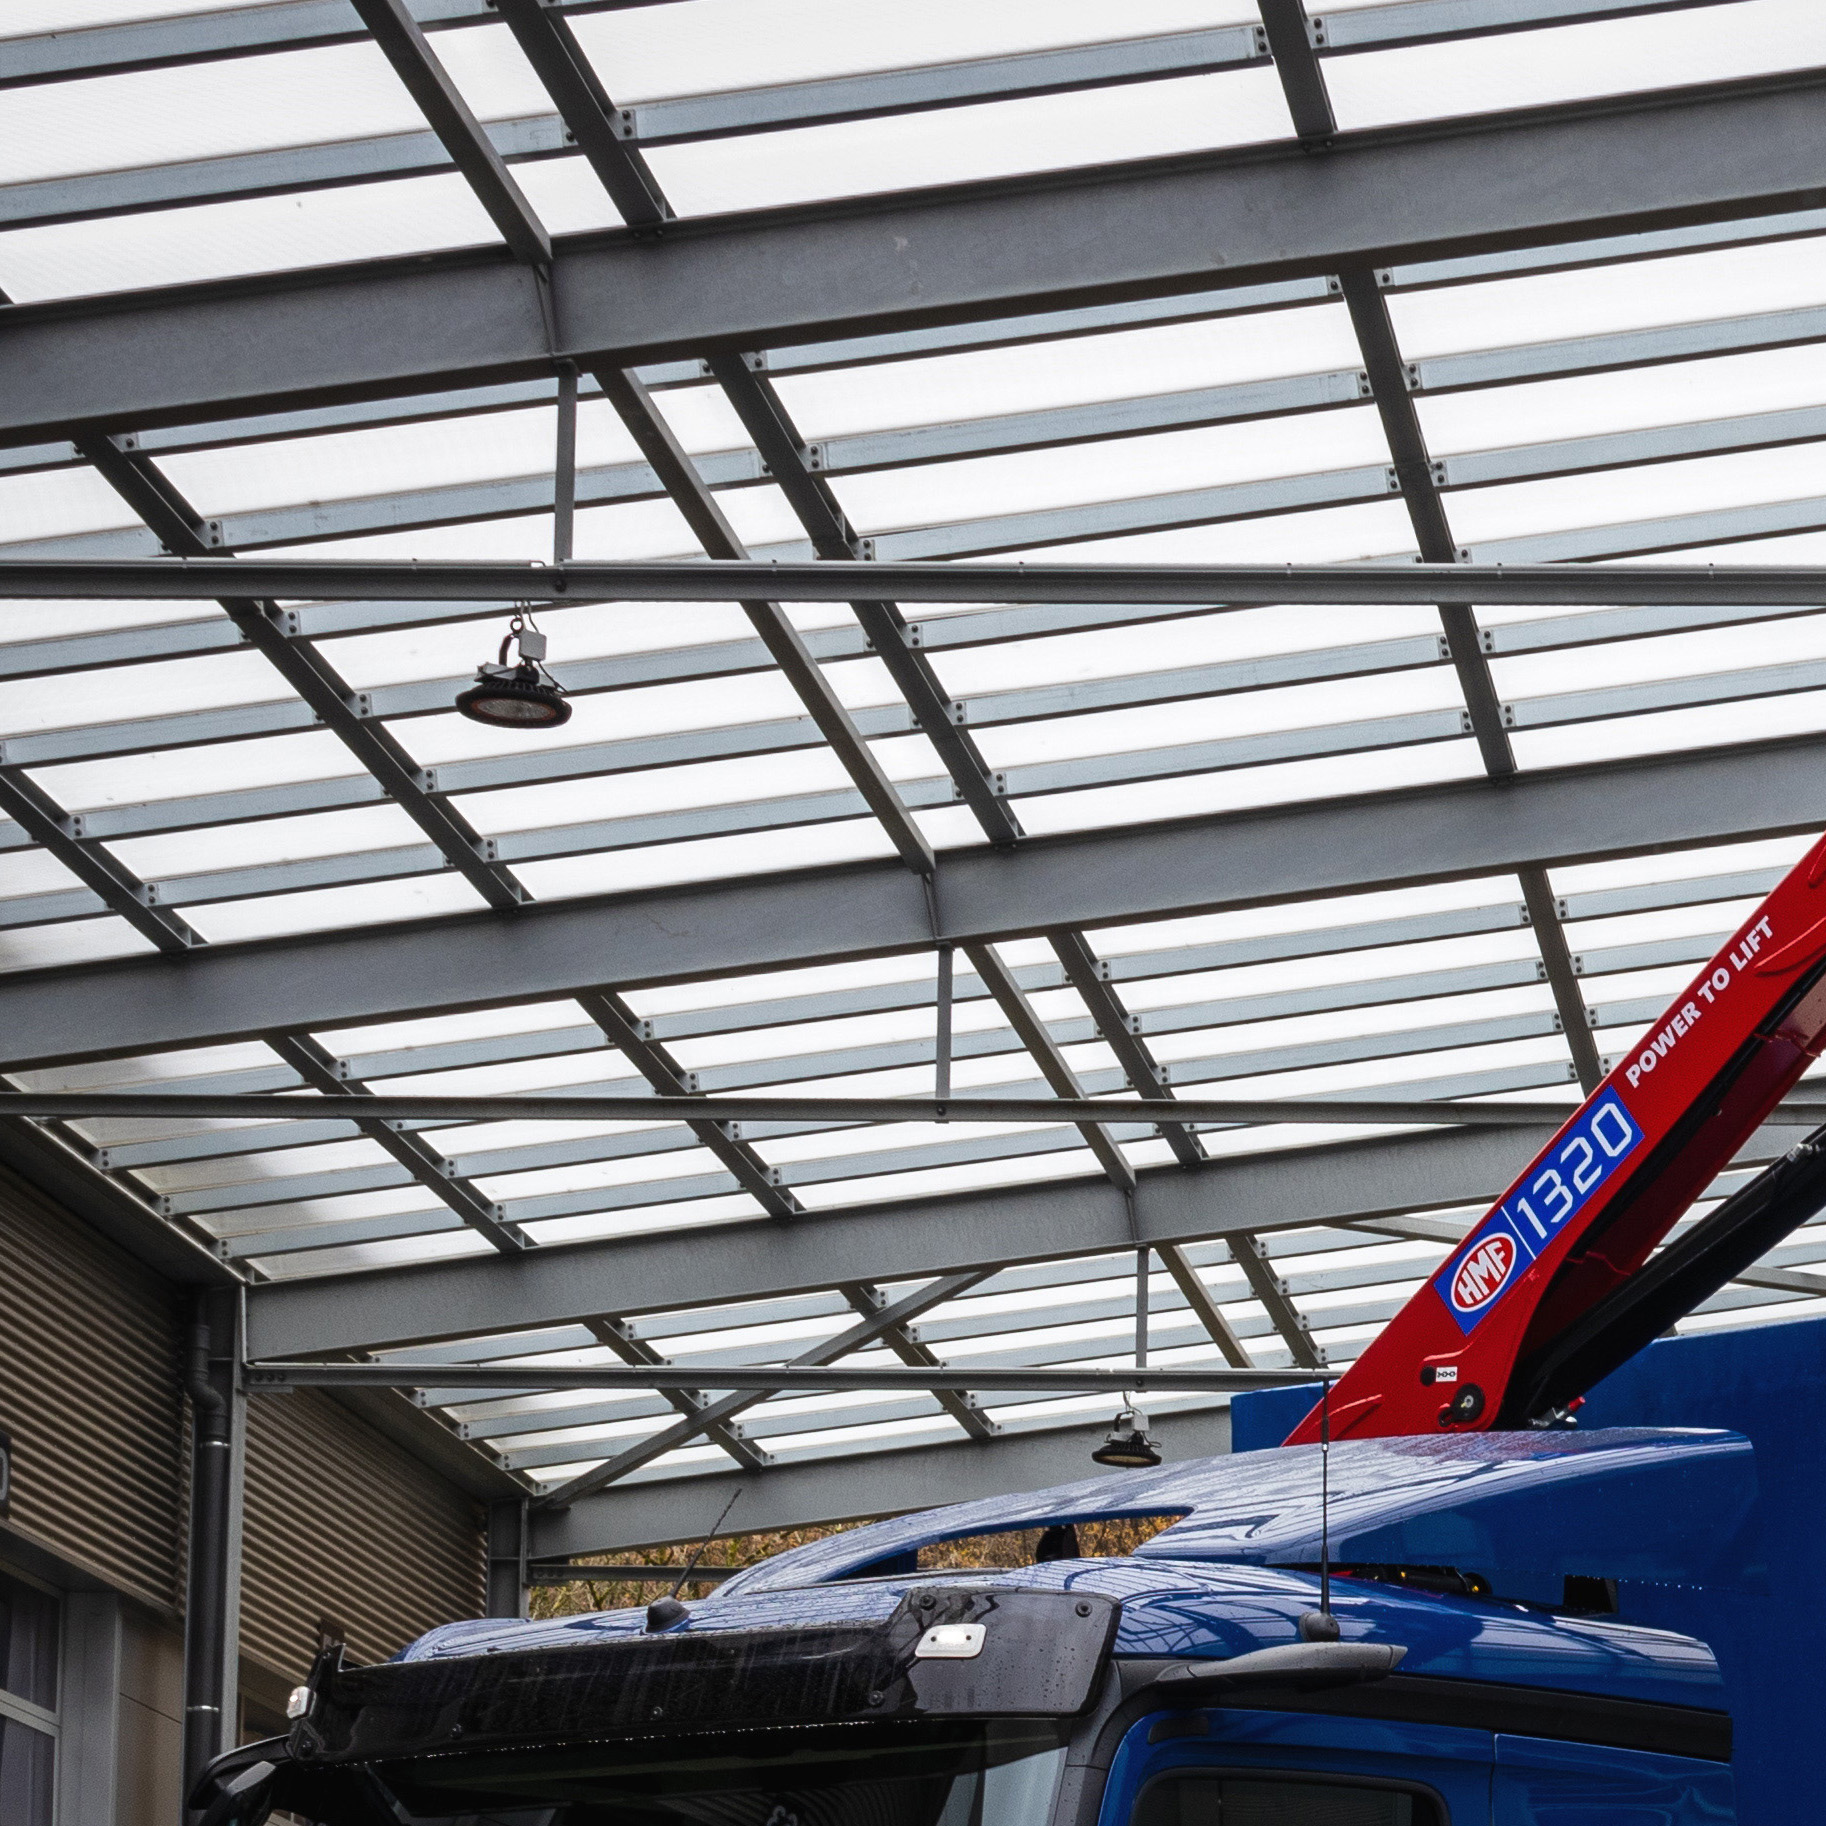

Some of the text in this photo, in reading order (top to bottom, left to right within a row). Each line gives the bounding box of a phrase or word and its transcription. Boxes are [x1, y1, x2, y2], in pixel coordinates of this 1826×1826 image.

[1625, 915, 1773, 1088] POWER TO LIFT
[1457, 1103, 1632, 1305] HMF 1320
